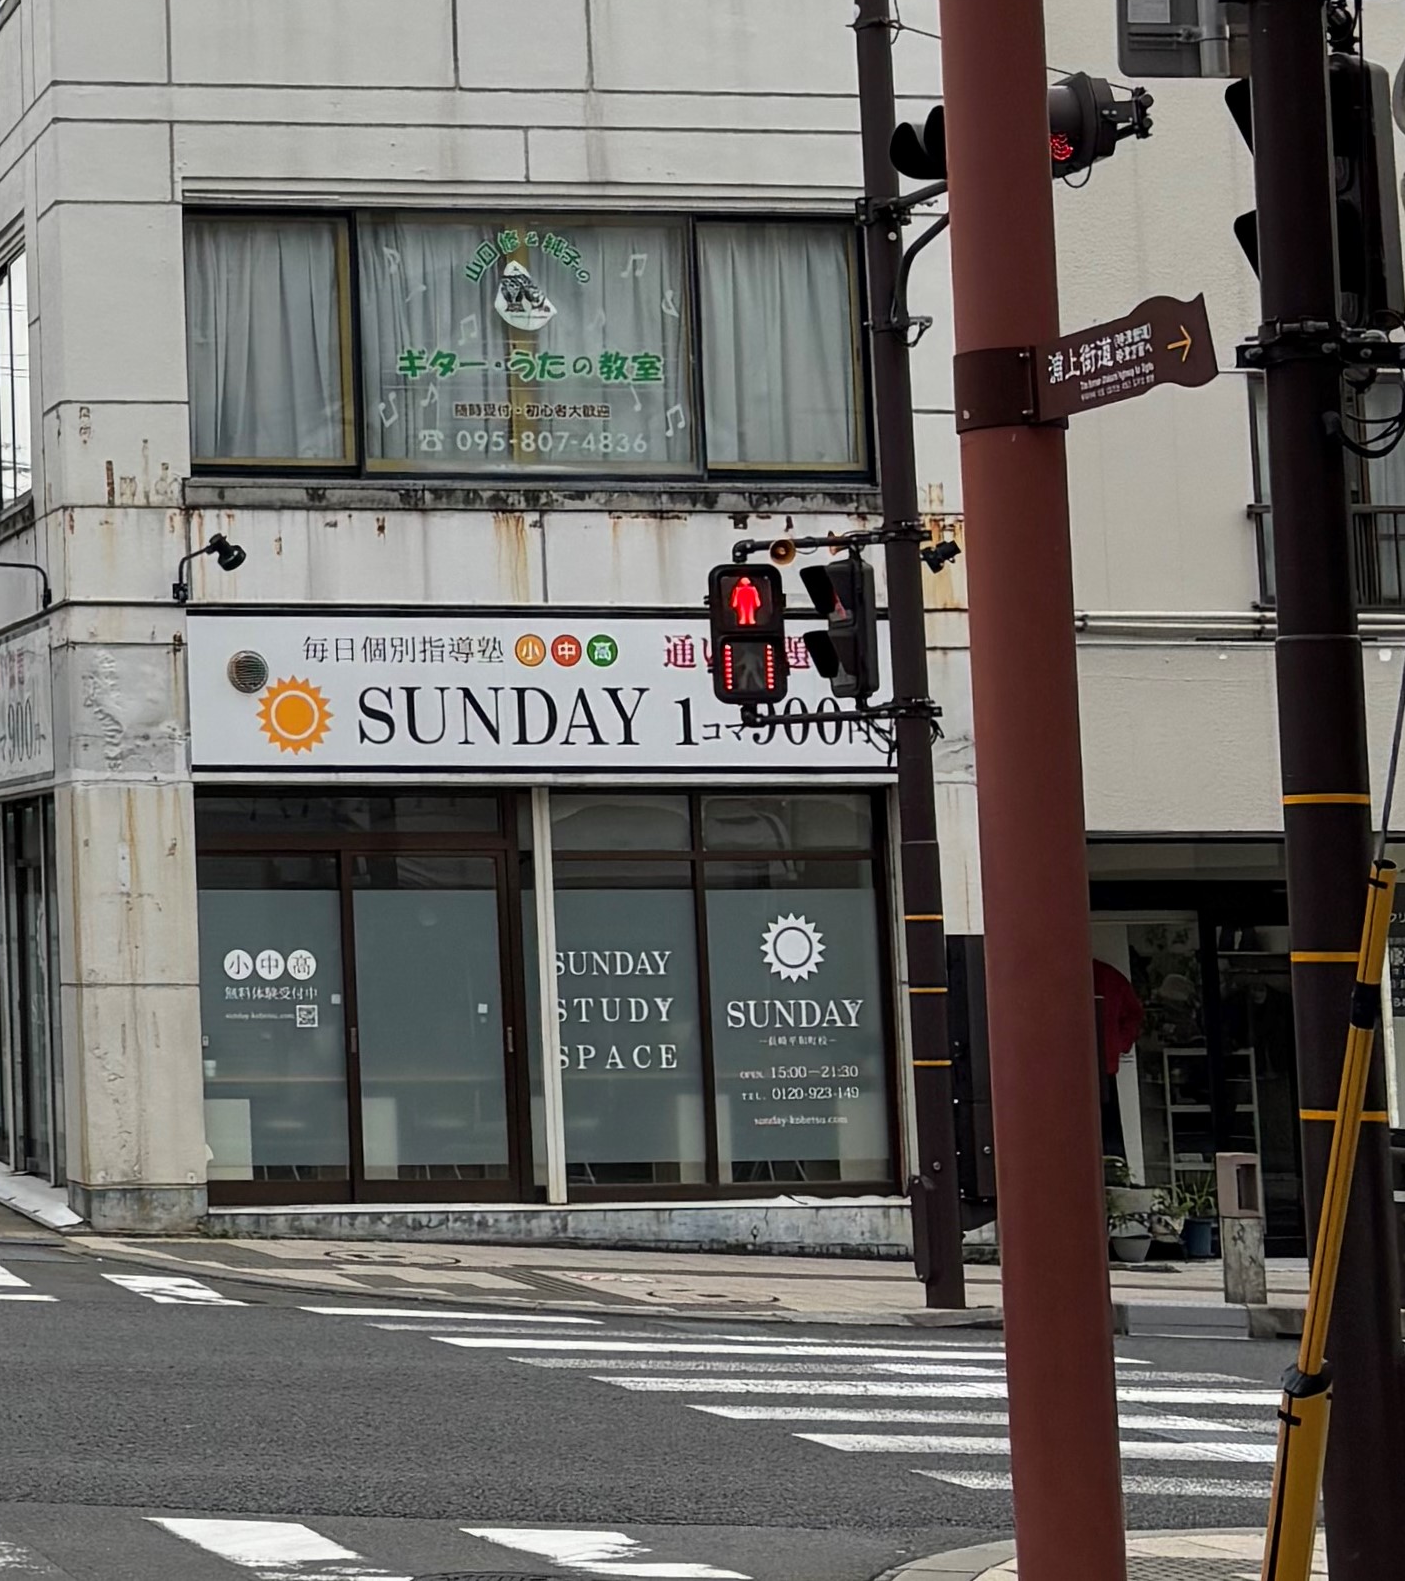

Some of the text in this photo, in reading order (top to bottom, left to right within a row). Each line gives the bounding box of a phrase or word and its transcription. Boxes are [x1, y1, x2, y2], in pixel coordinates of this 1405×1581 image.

[455, 429, 648, 453] 095-807-4836
[302, 635, 505, 664] 毎日個別指導塾
[358, 686, 650, 746] SUNDAY
[555, 950, 673, 976] SUNDAY
[557, 996, 675, 1023] STUDY
[726, 999, 865, 1029] SUNDAY
[559, 1043, 678, 1070] SPACE
